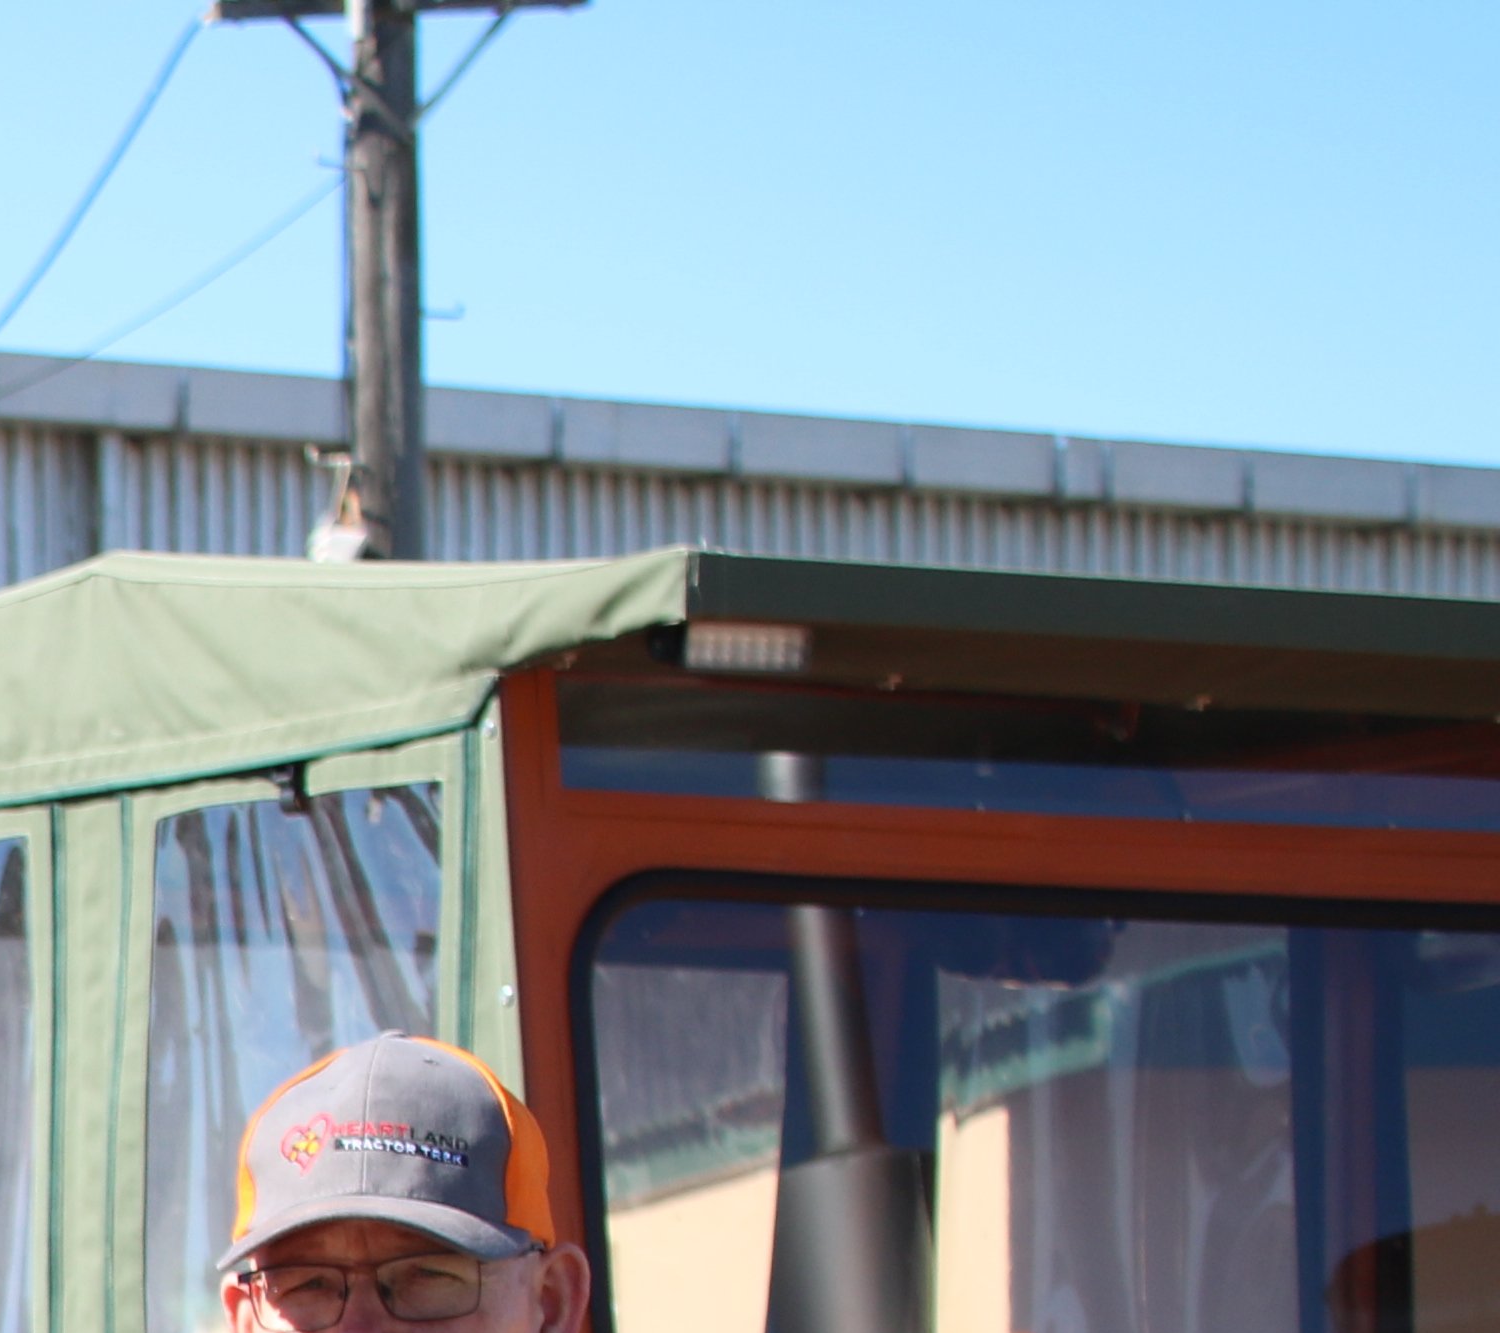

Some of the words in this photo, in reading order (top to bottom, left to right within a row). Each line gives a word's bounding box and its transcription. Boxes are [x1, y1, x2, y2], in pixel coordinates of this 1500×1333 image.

[330, 1121, 469, 1151] HEARTLAND
[341, 1138, 417, 1155] TRACTOR
[420, 1145, 463, 1166] TREK
